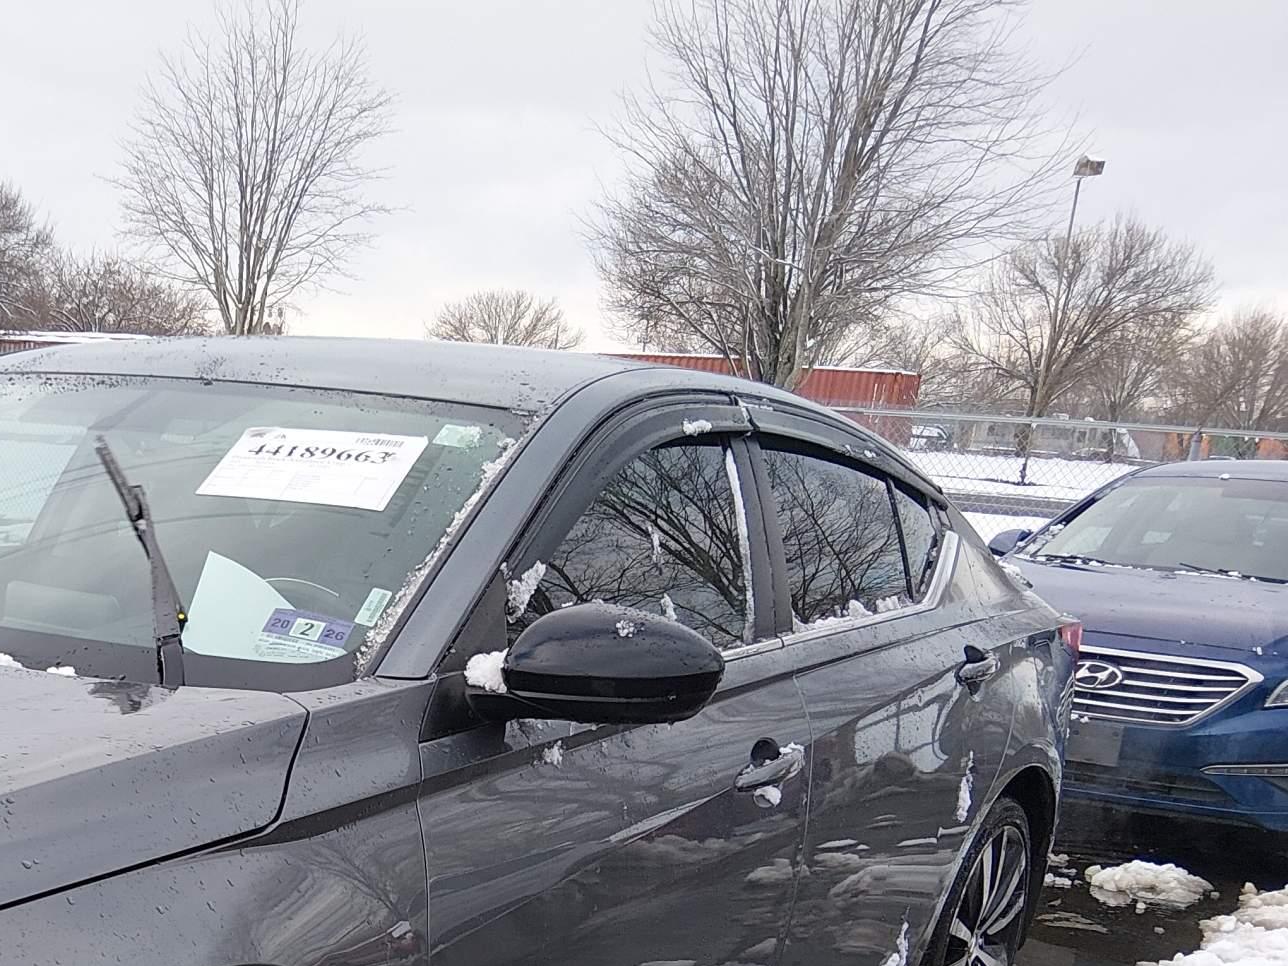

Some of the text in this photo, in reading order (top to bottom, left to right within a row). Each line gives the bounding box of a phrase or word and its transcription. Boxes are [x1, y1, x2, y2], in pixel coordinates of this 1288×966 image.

[248, 443, 395, 465] 44189663
[271, 618, 345, 641] 20 2 26
